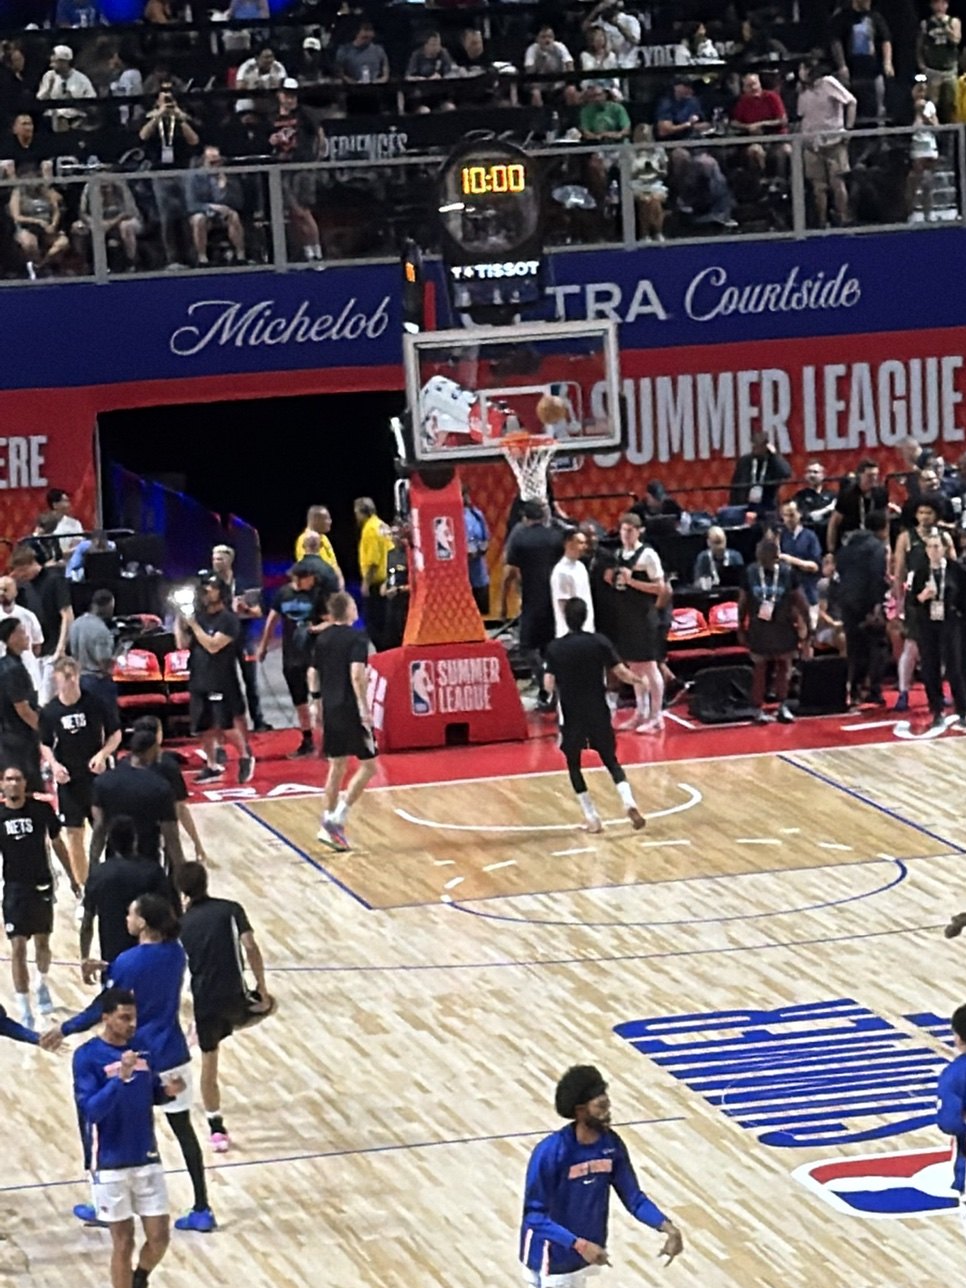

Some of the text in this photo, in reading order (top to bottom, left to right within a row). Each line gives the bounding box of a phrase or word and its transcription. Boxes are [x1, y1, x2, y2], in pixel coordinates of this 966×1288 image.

[462, 164, 525, 194] 10:00
[474, 261, 540, 279] TISSOT
[170, 297, 390, 356] Michelob
[684, 263, 861, 321] Courtside
[591, 354, 964, 468] SUMMER LEAGUE
[436, 657, 501, 687] SUMMER
[437, 683, 492, 713] LEAGUE
[4, 818, 34, 836] NETS
